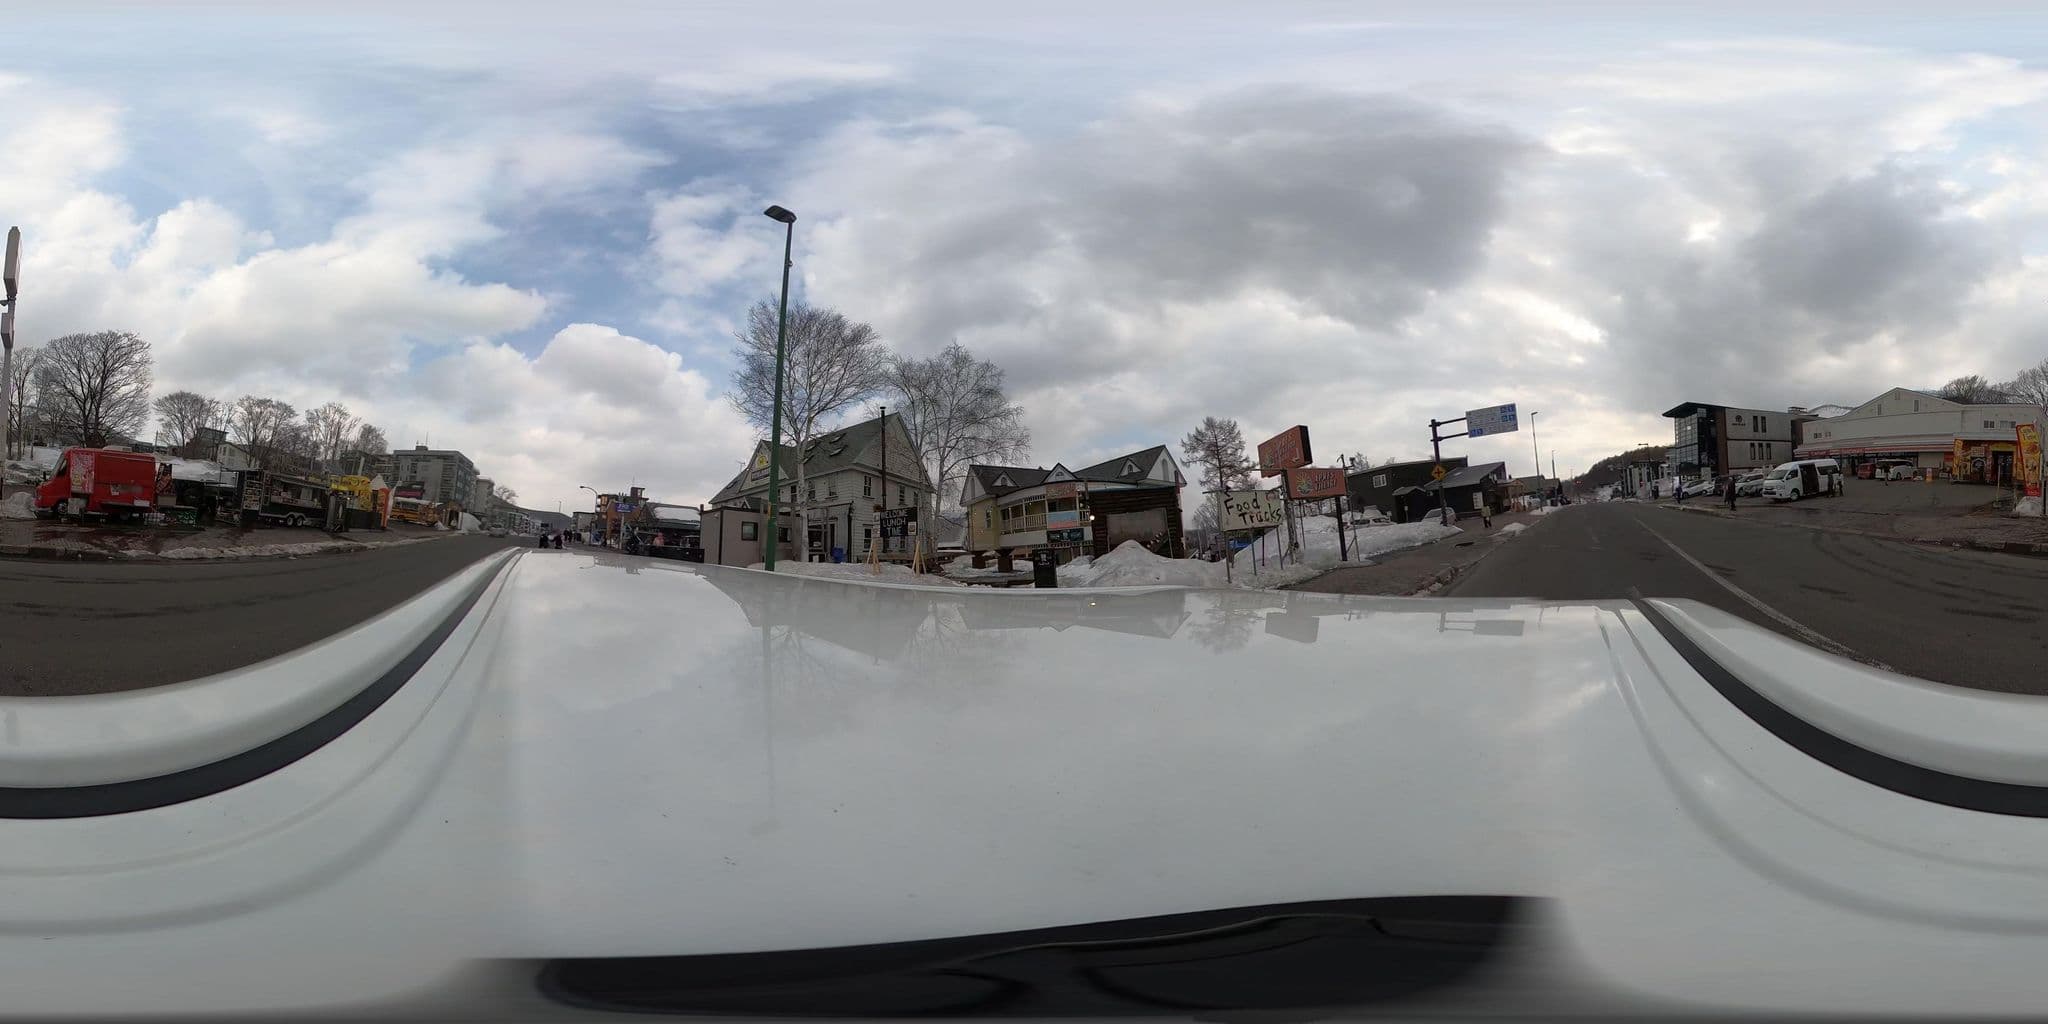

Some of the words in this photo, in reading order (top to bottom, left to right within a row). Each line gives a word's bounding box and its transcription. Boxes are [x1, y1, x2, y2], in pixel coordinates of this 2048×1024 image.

[1224, 492, 1260, 515] Food
[1238, 503, 1282, 525] Trucks
[882, 517, 905, 528] LUNCH
